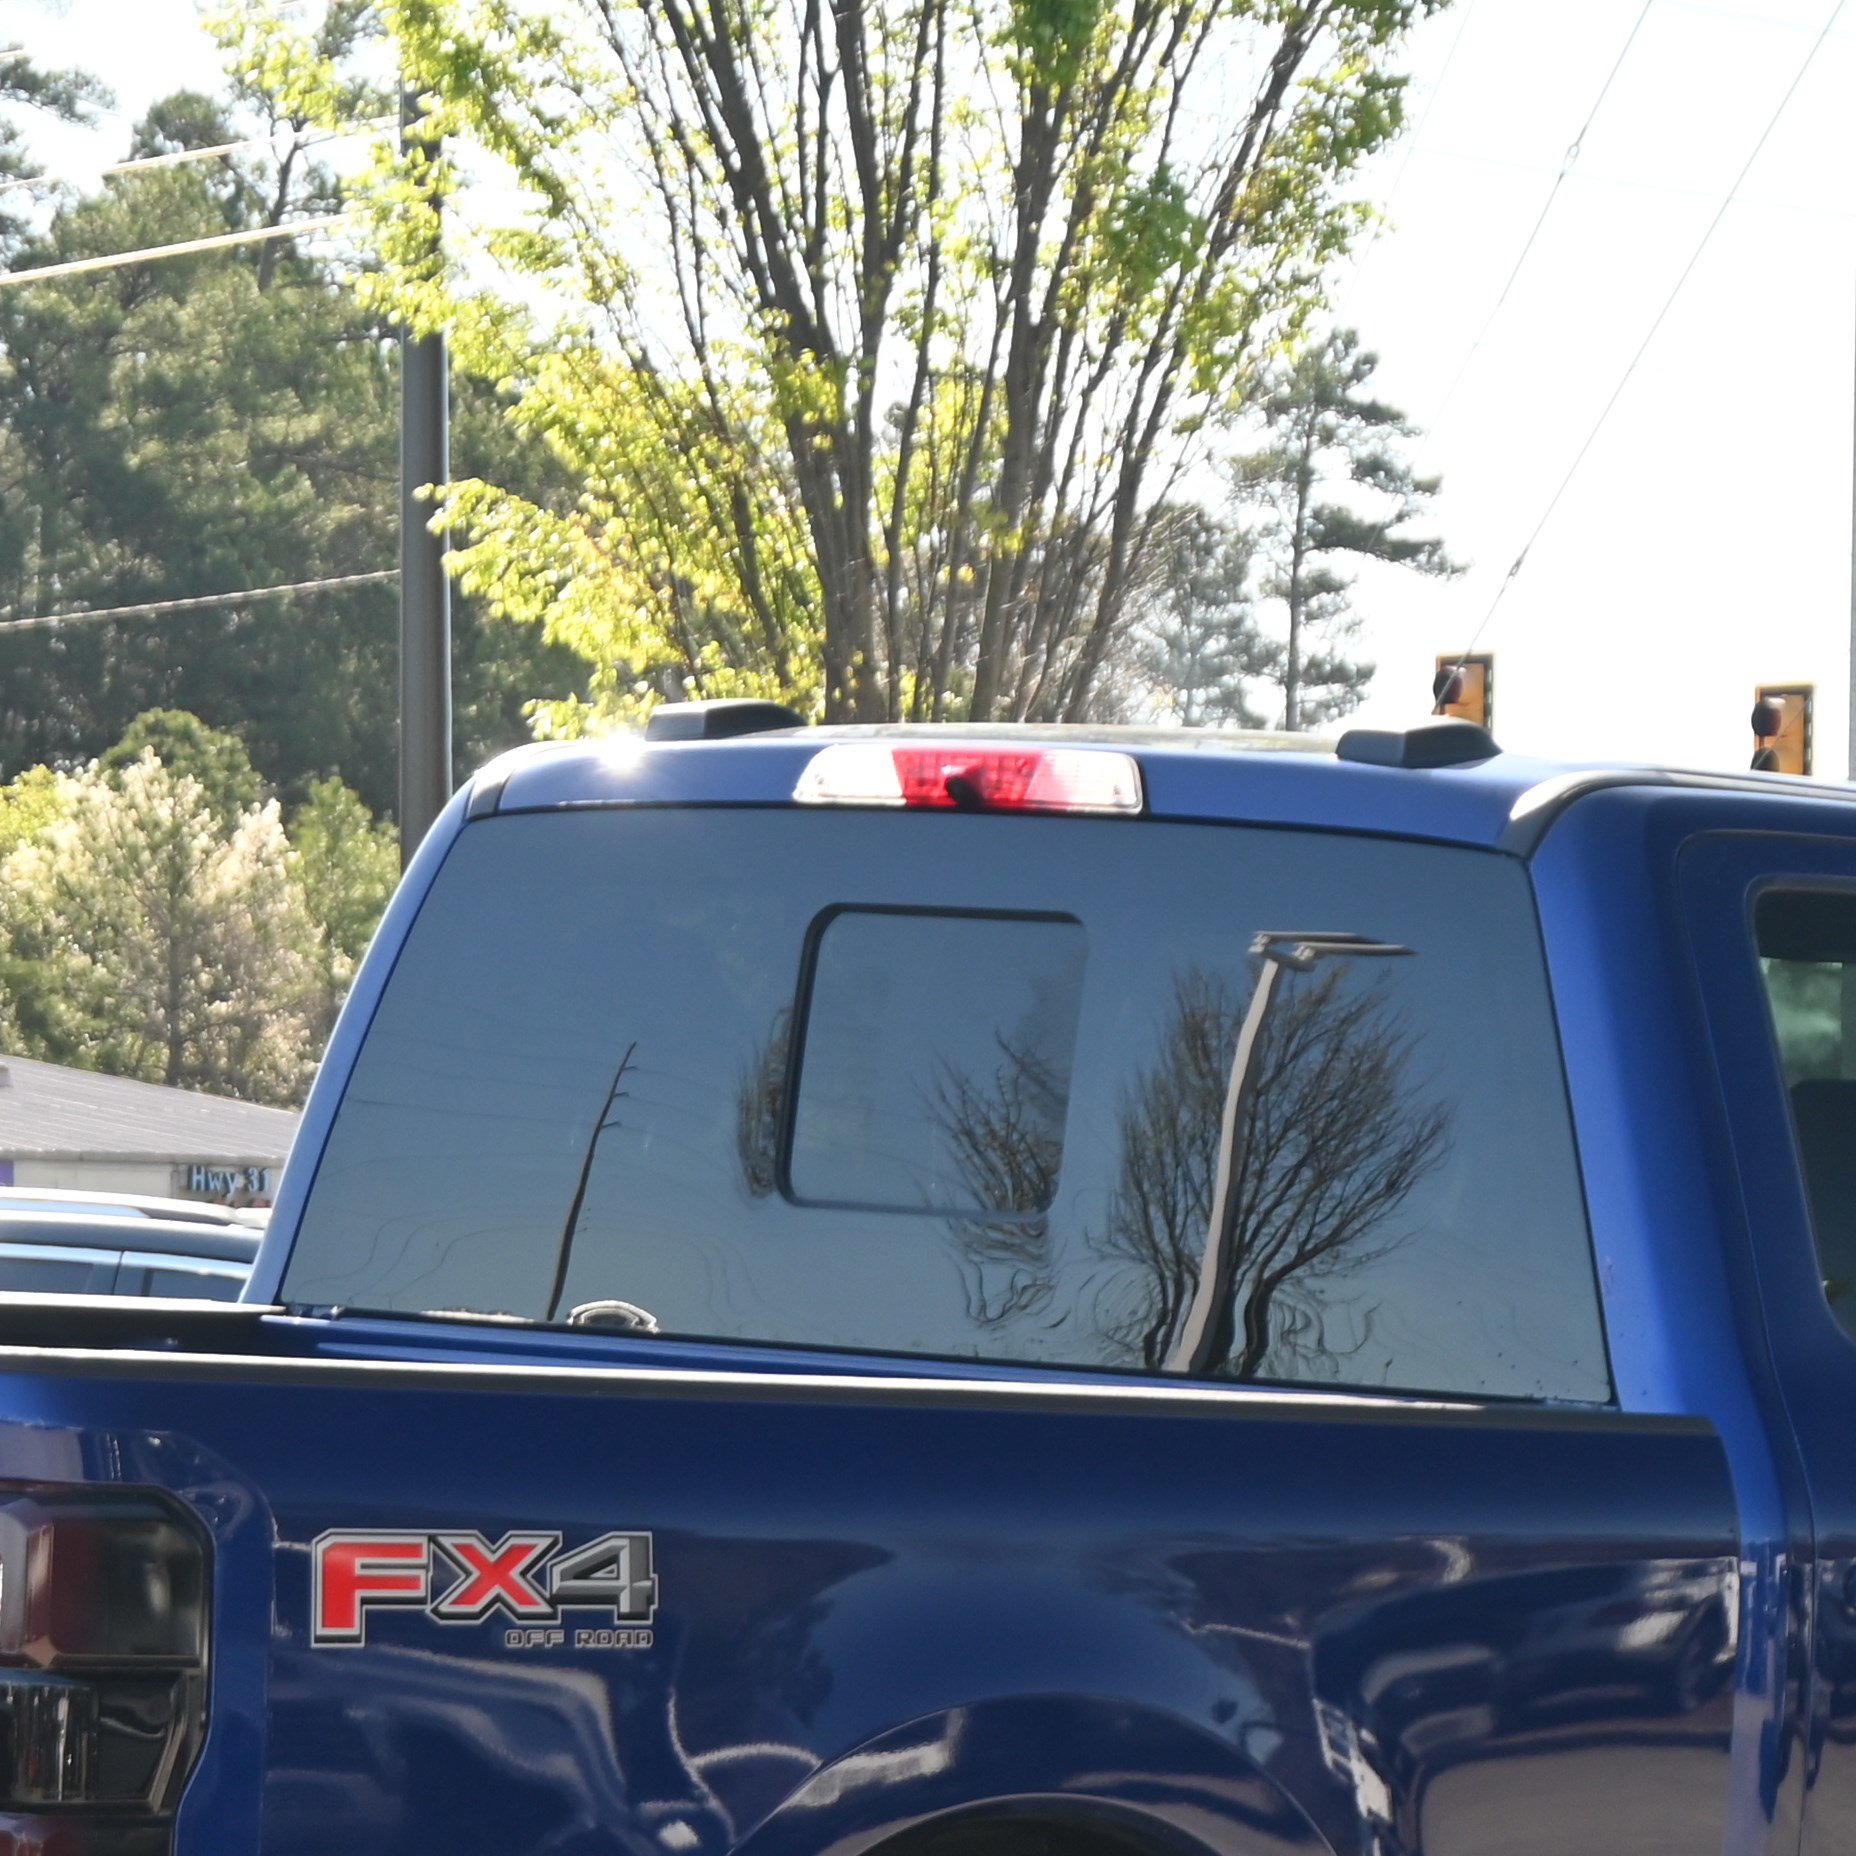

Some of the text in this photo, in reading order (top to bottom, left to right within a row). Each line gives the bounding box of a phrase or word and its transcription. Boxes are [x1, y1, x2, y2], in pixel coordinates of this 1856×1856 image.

[191, 1165, 272, 1203] Hwy 31
[310, 1528, 658, 1648] FX4
[505, 1630, 654, 1648] OFF ROAD
